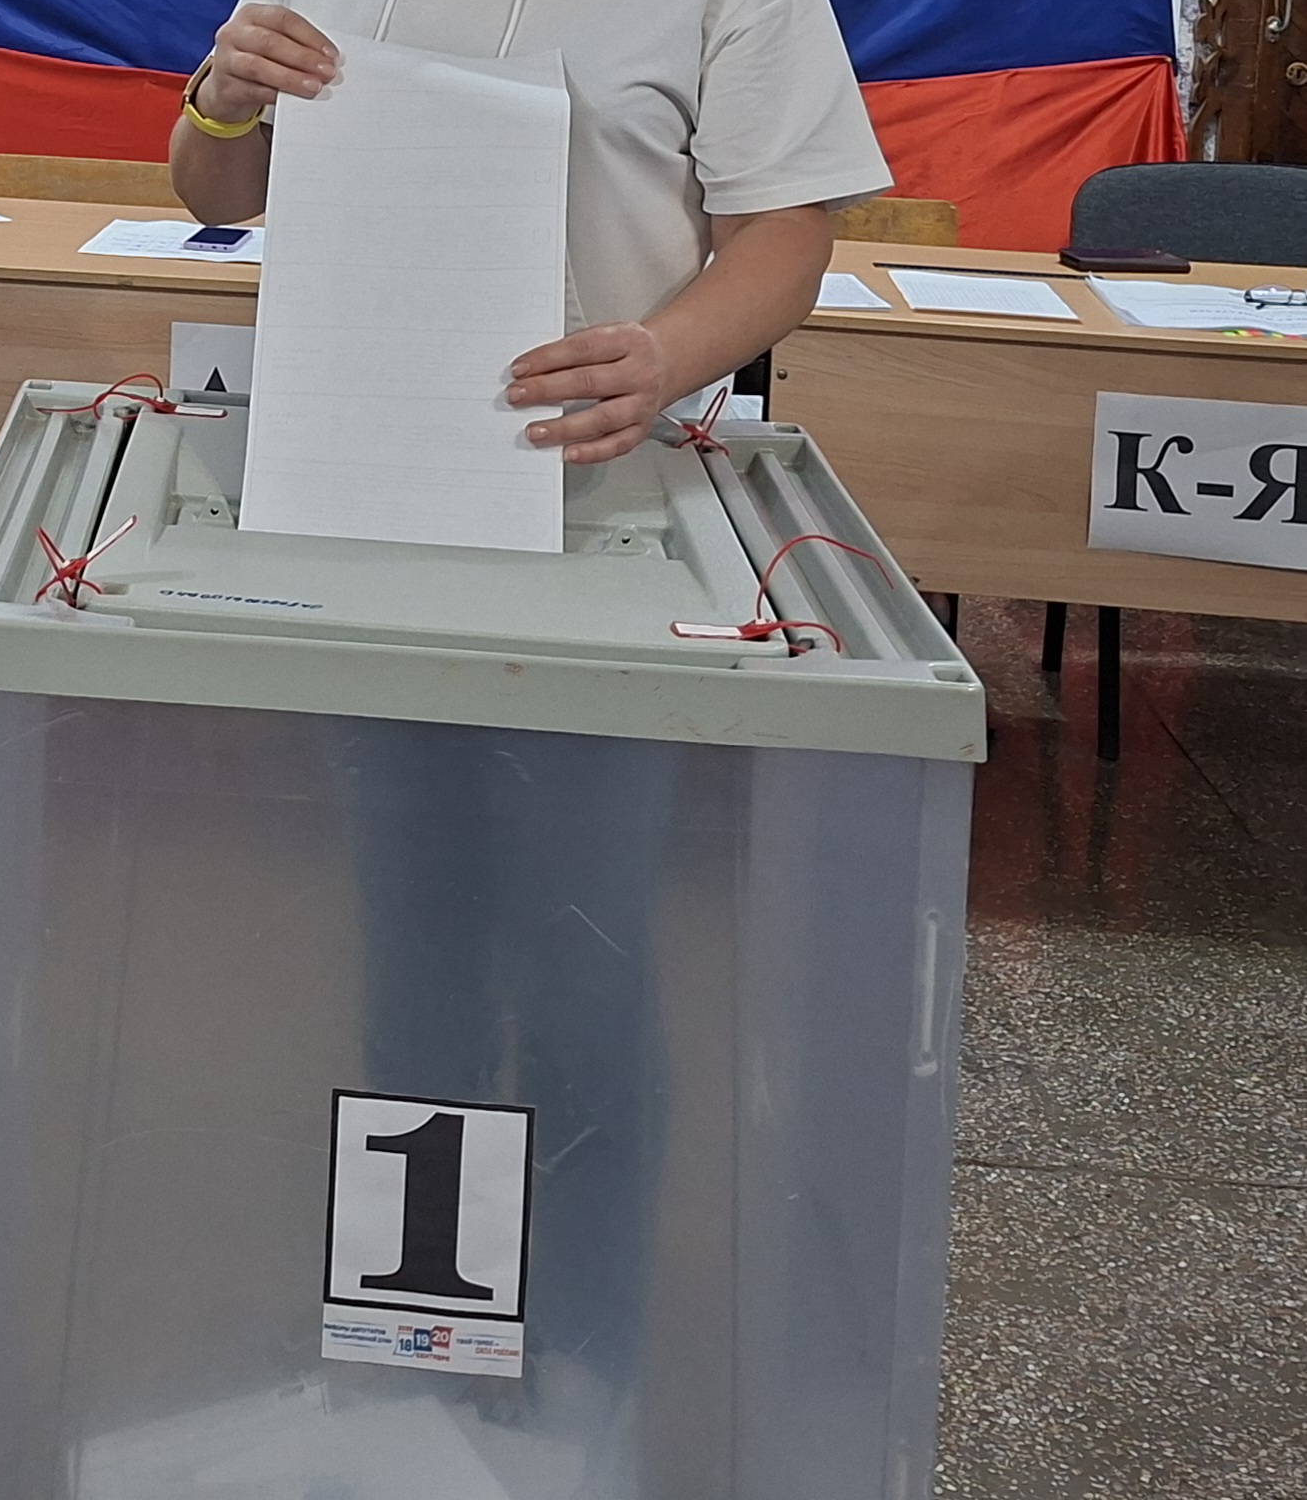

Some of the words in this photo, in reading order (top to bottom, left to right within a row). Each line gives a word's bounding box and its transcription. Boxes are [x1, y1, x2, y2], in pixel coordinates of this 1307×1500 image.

[1103, 430, 1307, 524] К-Я
[359, 1111, 494, 1301] 1
[399, 1338, 412, 1351] 18
[415, 1334, 429, 1347] 19
[432, 1331, 449, 1343] 20
